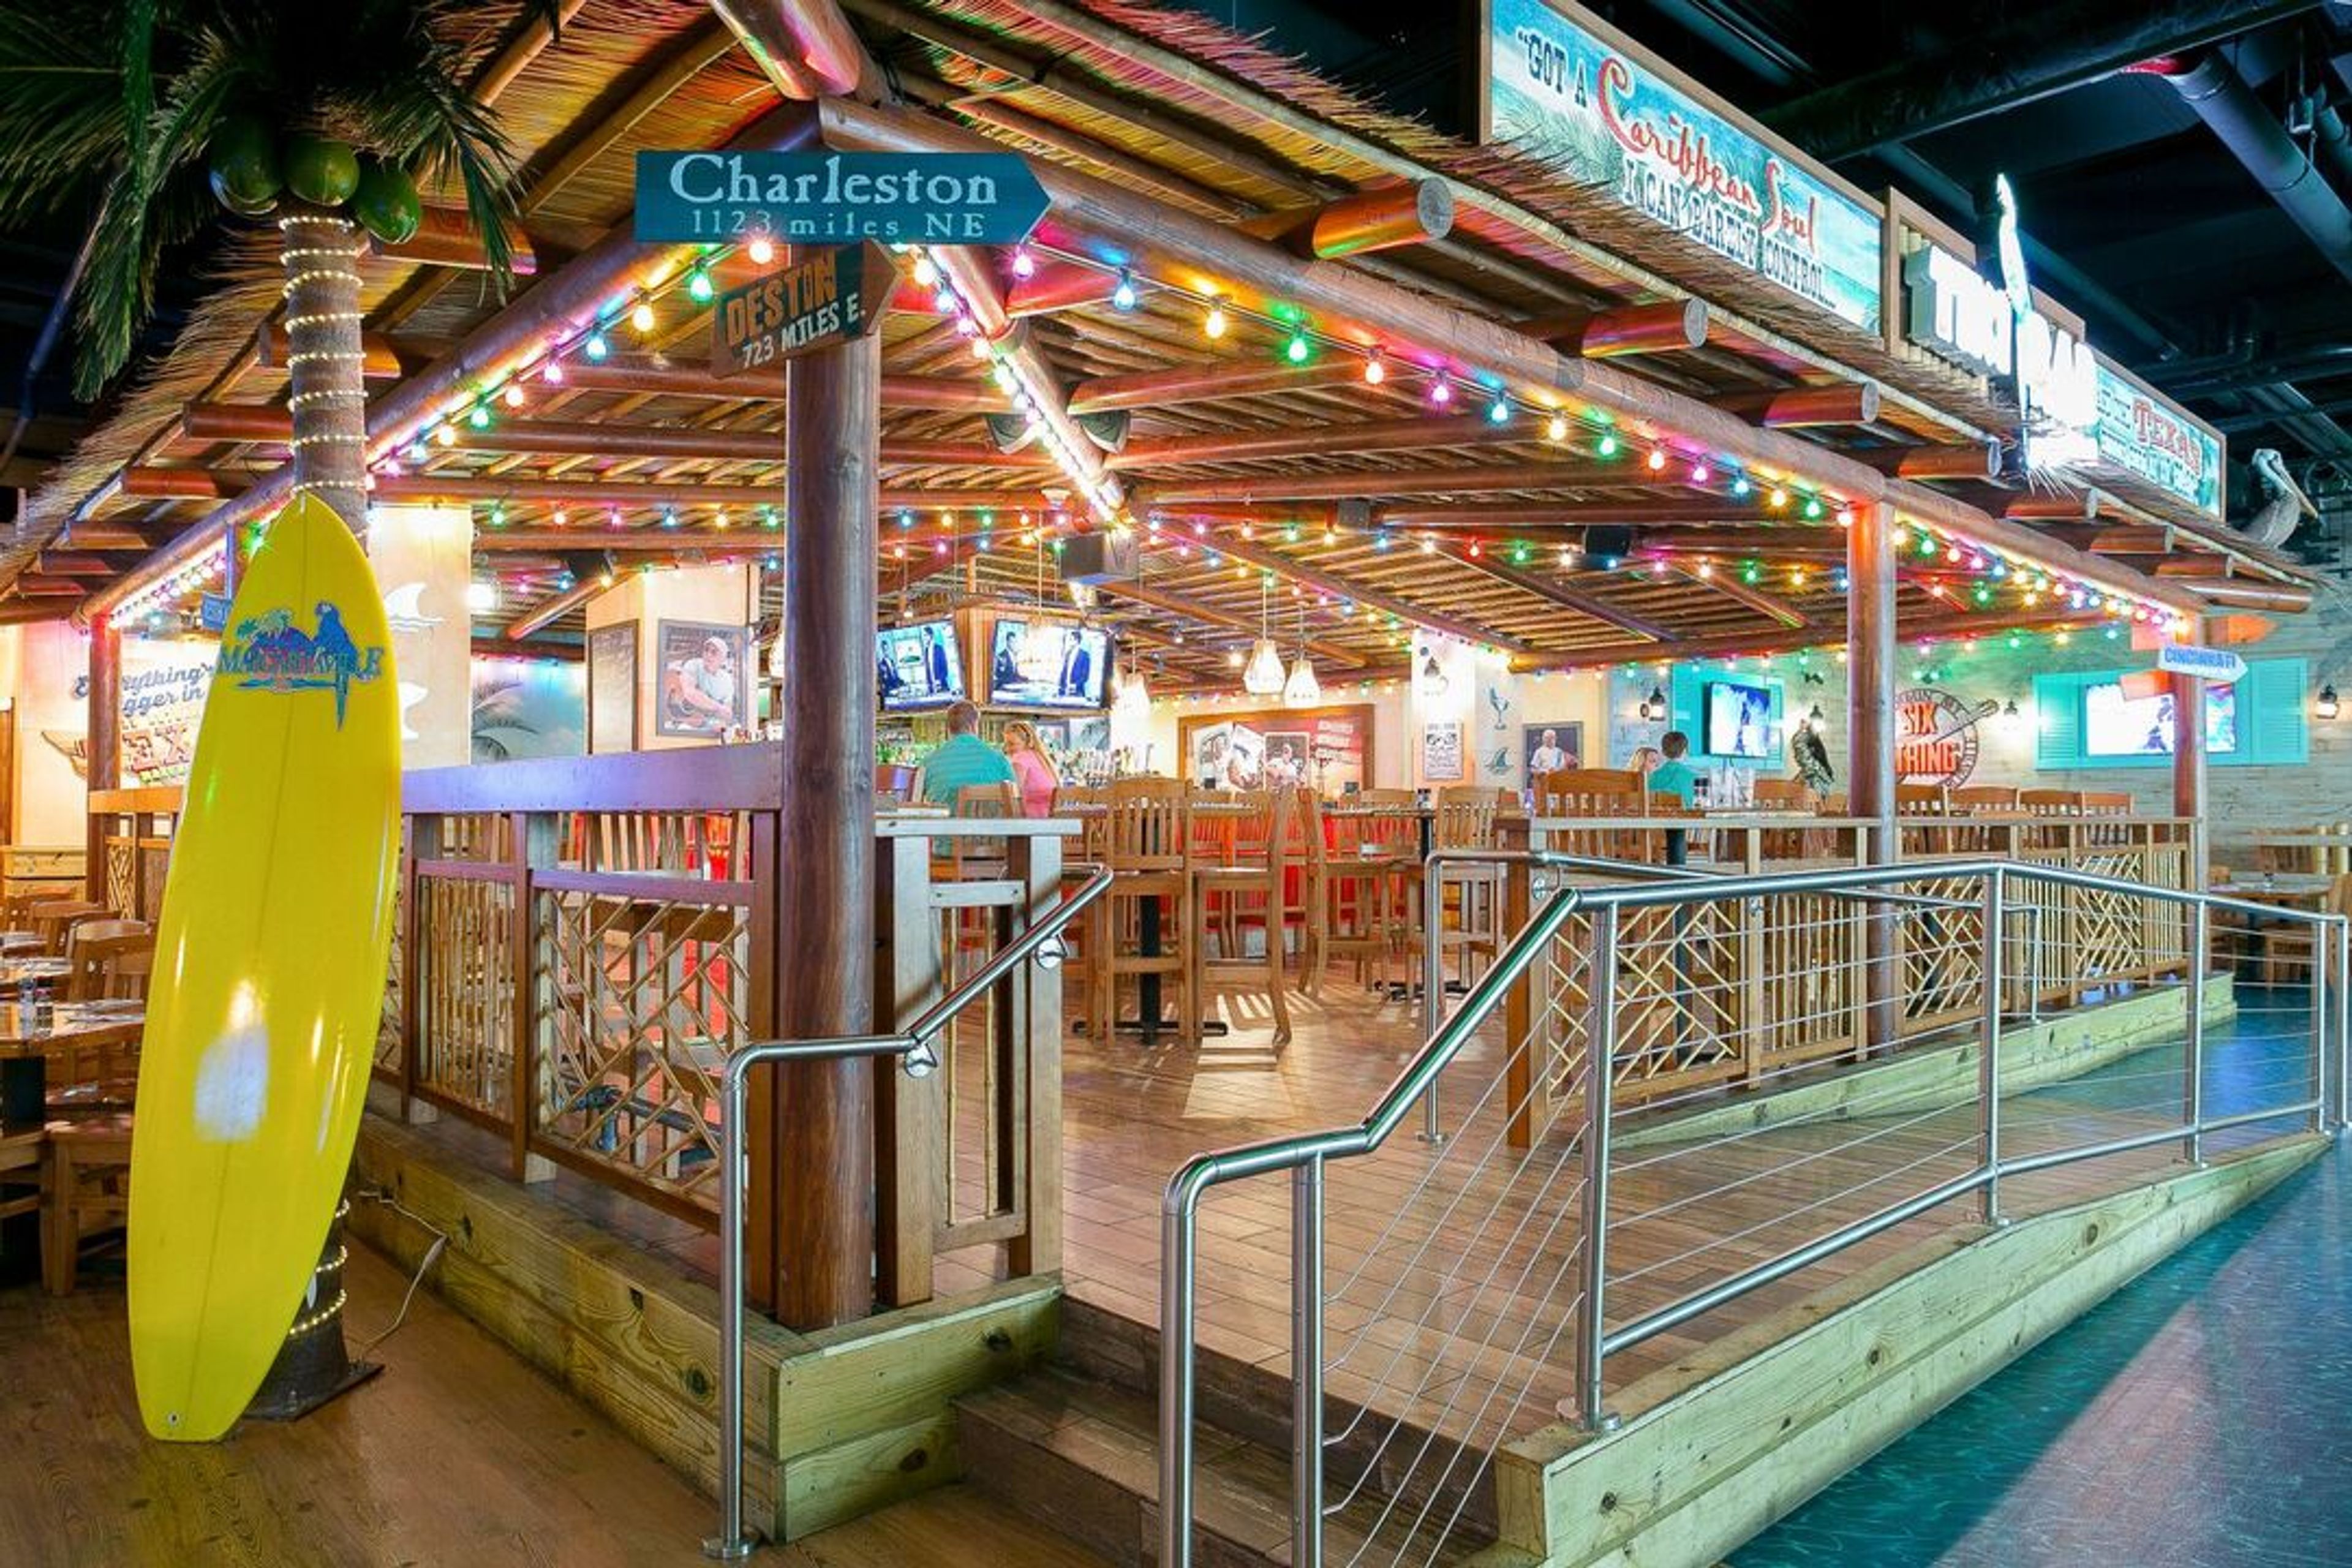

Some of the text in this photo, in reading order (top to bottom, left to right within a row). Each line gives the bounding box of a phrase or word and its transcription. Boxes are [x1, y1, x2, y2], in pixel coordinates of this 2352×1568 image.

[669, 154, 997, 205] Charleston
[1575, 62, 1587, 108] A
[1598, 58, 1762, 213] Caribbean
[1760, 161, 1815, 252] Soul
[693, 210, 985, 238] 1123 miles NE
[1645, 171, 1683, 230] CAN
[742, 292, 866, 369] 723 MILES E.
[2133, 399, 2203, 477] TEXAS
[182, 684, 205, 702] in
[1902, 703, 1939, 735] SIX
